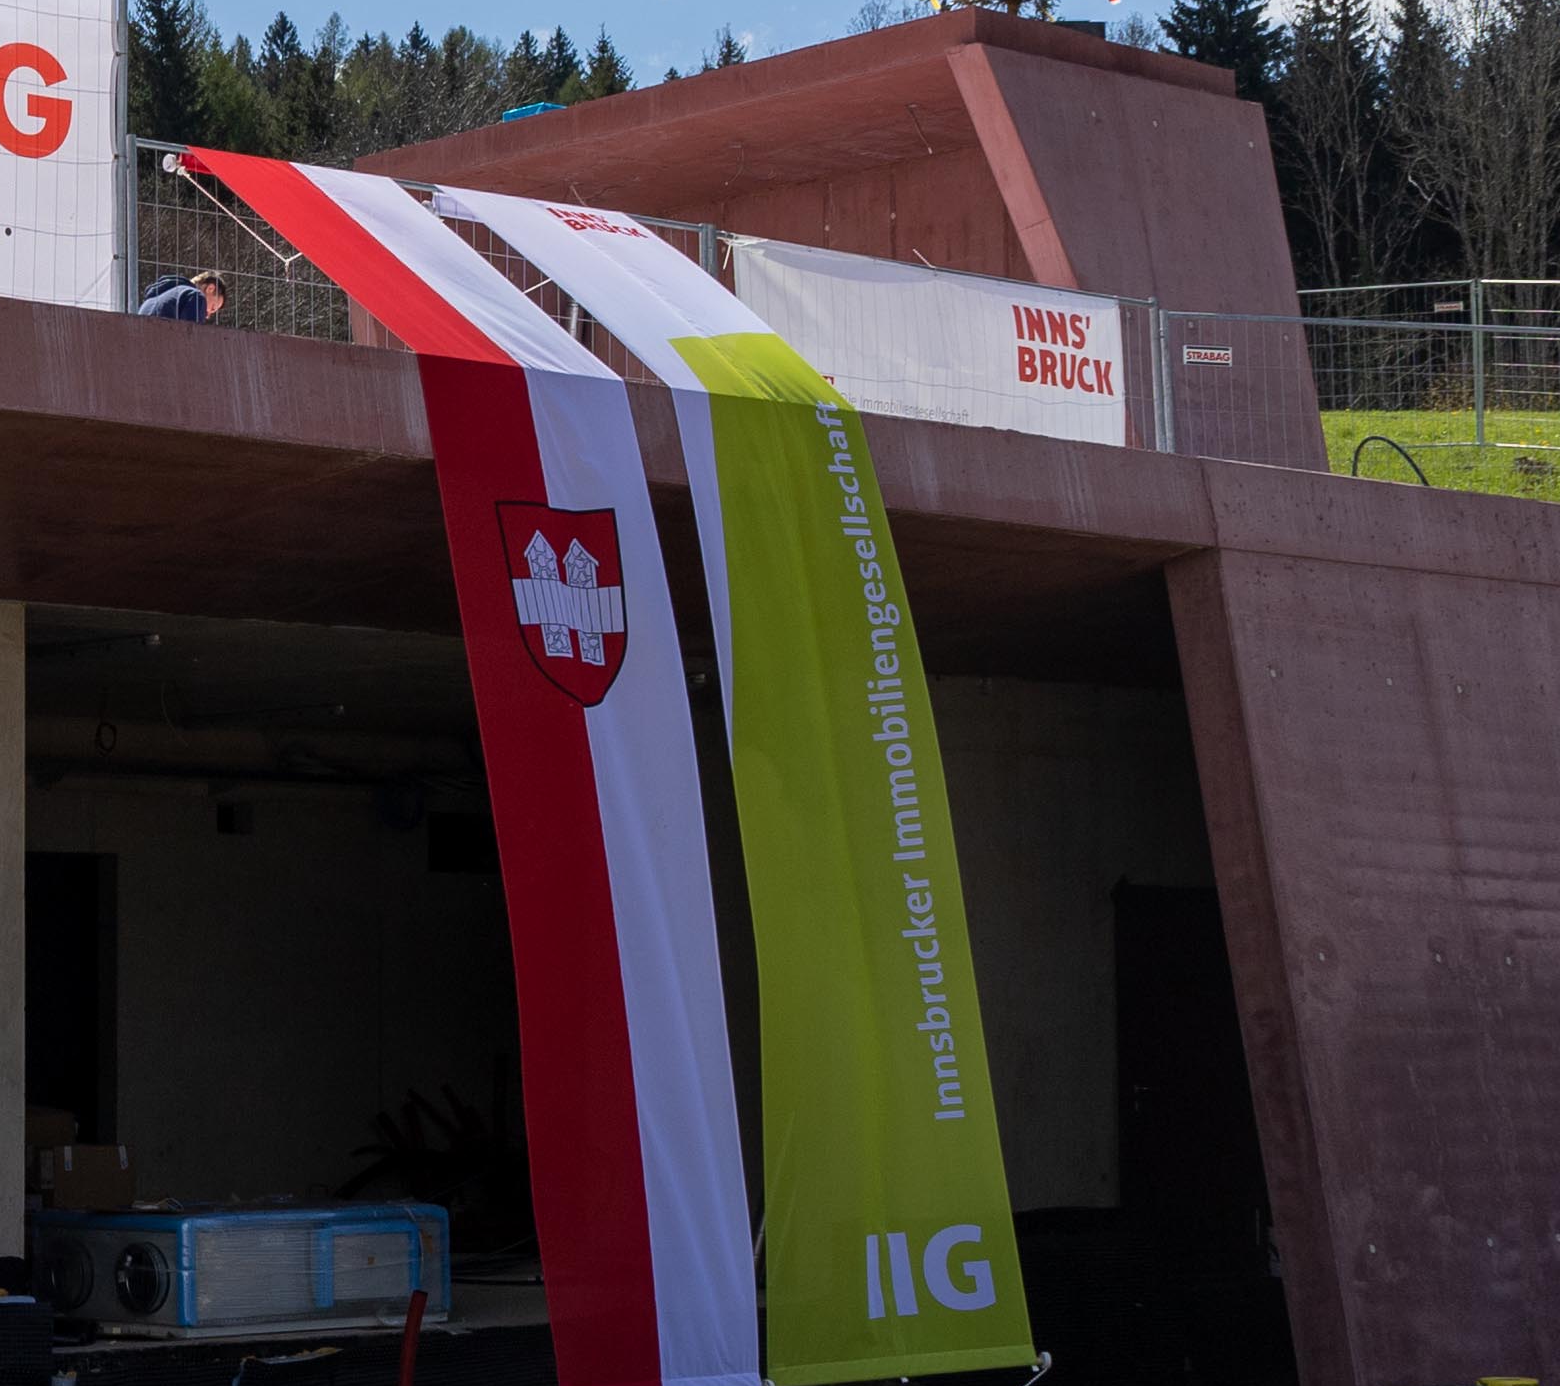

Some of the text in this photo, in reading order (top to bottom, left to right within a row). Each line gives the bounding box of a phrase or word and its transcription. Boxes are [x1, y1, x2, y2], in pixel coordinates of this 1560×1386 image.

[1017, 345, 1115, 397] BRUCK
[1185, 350, 1231, 363] STRABAG
[860, 395, 970, 424] Immobiliengesellschaft
[816, 399, 965, 1121] Innsbrucker Immobiliengesellschaft
